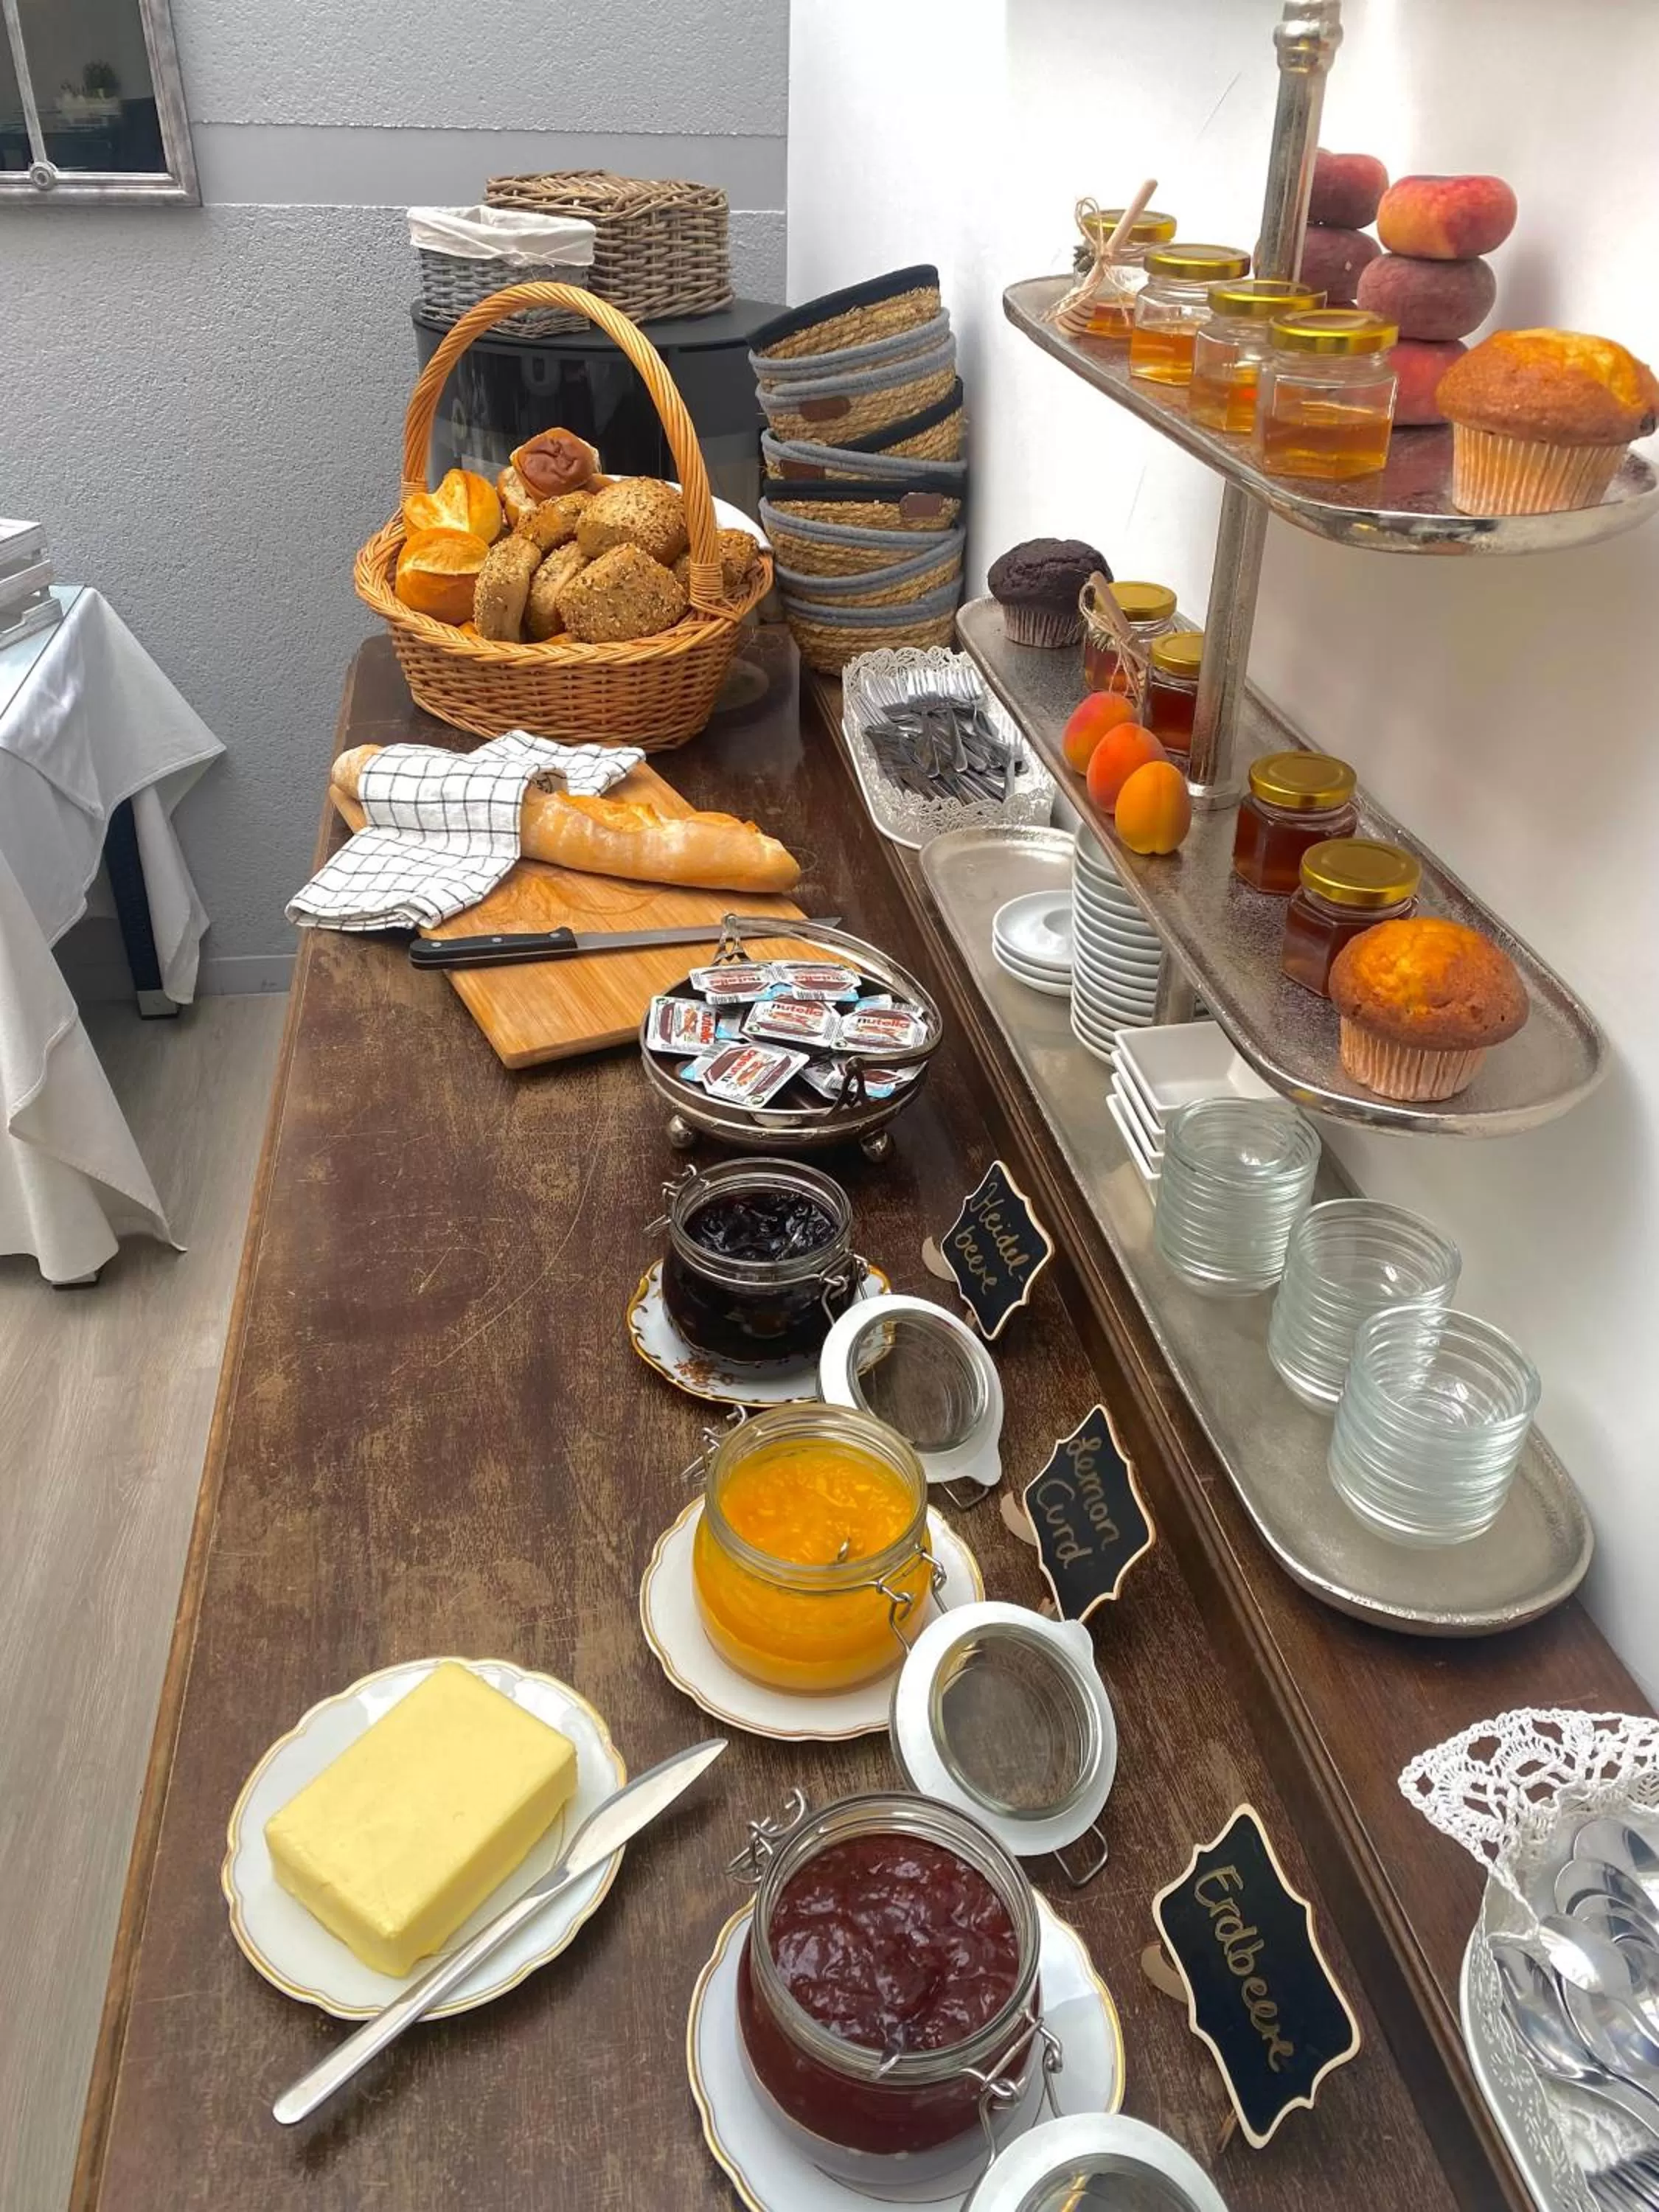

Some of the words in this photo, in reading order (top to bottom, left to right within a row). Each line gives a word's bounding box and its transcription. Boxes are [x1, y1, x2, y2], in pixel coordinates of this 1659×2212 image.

[771, 1004, 824, 1017] nutella
[858, 1017, 910, 1029] nutella
[720, 1049, 756, 1082] nutella
[955, 1225, 998, 1295] beere
[1037, 1478, 1093, 1569] Curd
[1194, 1864, 1295, 2073] Erdbeere
